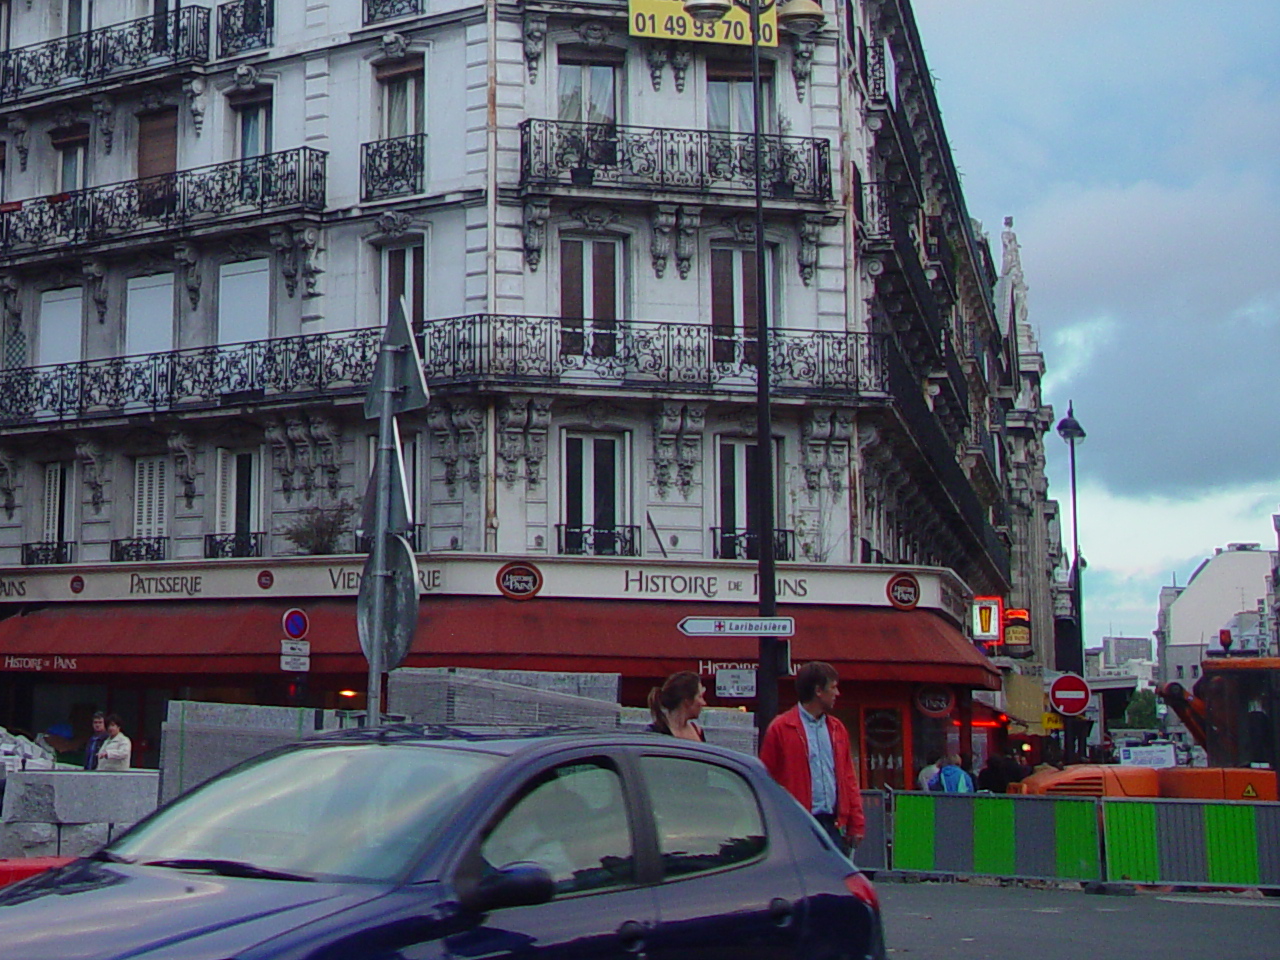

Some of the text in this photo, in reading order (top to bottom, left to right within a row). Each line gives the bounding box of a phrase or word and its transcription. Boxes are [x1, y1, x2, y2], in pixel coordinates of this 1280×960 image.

[635, 12, 656, 34] 01
[664, 15, 687, 36] 49
[693, 20, 716, 39] 93
[722, 20, 745, 41] 70
[130, 573, 202, 596] PATISSERIE
[624, 570, 718, 598] HISTOIRE
[728, 580, 743, 591] DE
[729, 622, 787, 631] Lariboisière
